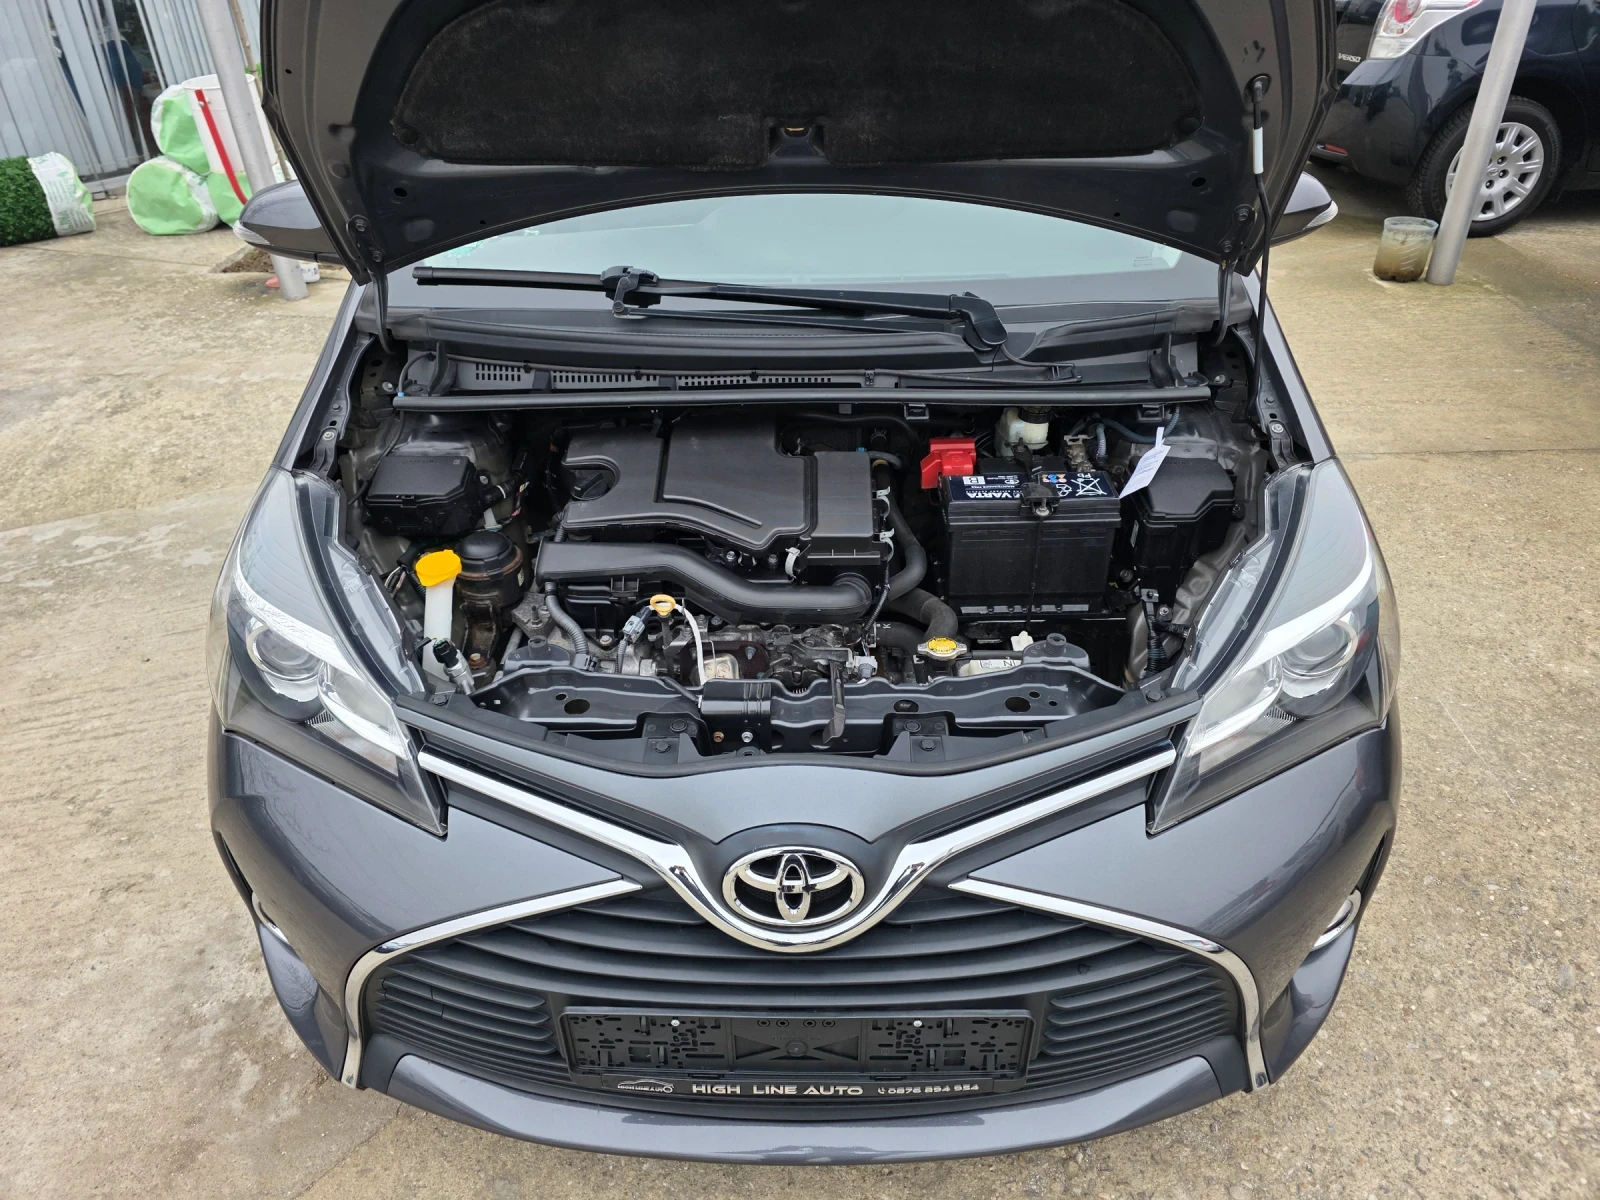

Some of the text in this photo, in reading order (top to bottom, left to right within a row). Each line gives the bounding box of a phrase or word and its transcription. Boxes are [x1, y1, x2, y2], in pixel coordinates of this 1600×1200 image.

[1338, 53, 1361, 63] VERSO
[692, 1083, 741, 1094] HIGH
[752, 1084, 798, 1095] LINE
[803, 1085, 864, 1096] AUTO
